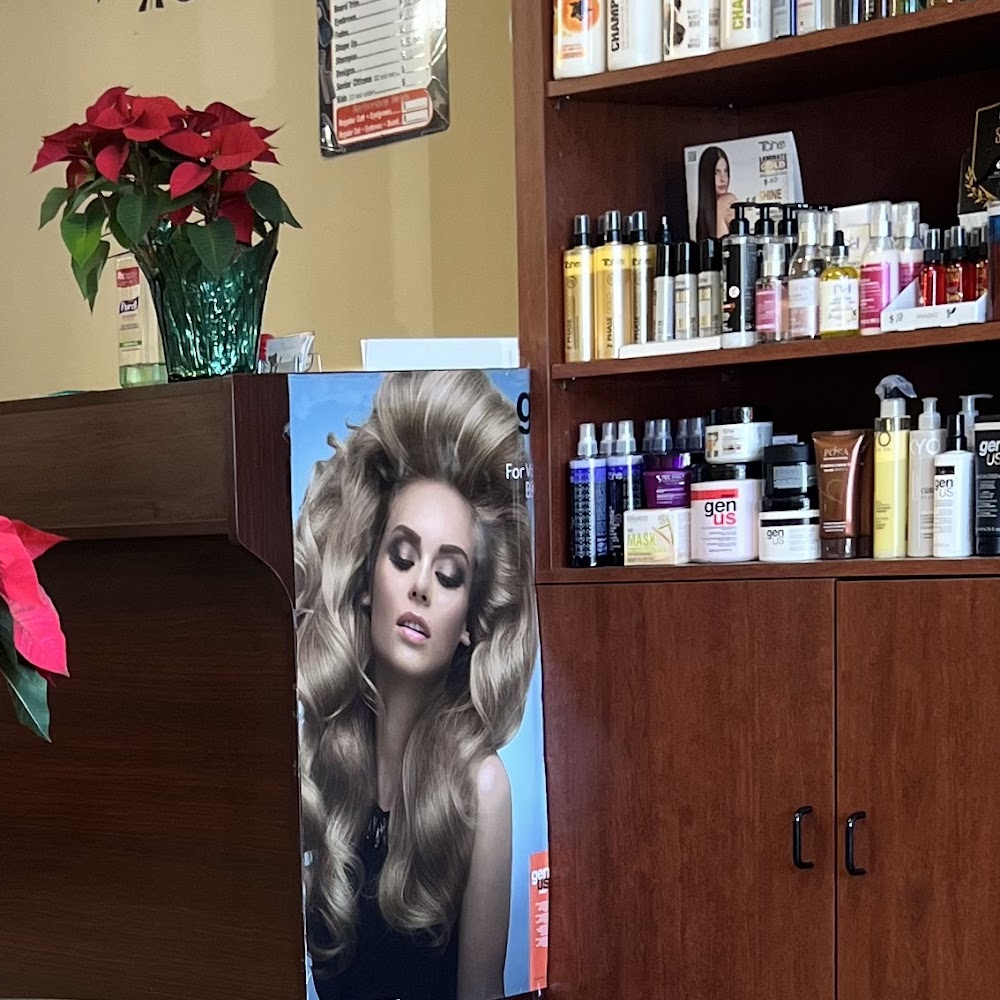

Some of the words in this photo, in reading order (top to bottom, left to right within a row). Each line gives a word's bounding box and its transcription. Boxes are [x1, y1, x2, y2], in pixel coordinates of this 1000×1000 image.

[505, 462, 525, 479] For
[704, 499, 737, 517] gen
[713, 512, 737, 526] us
[627, 533, 657, 548] MASK
[766, 529, 785, 540] gen
[531, 867, 550, 885] gen
